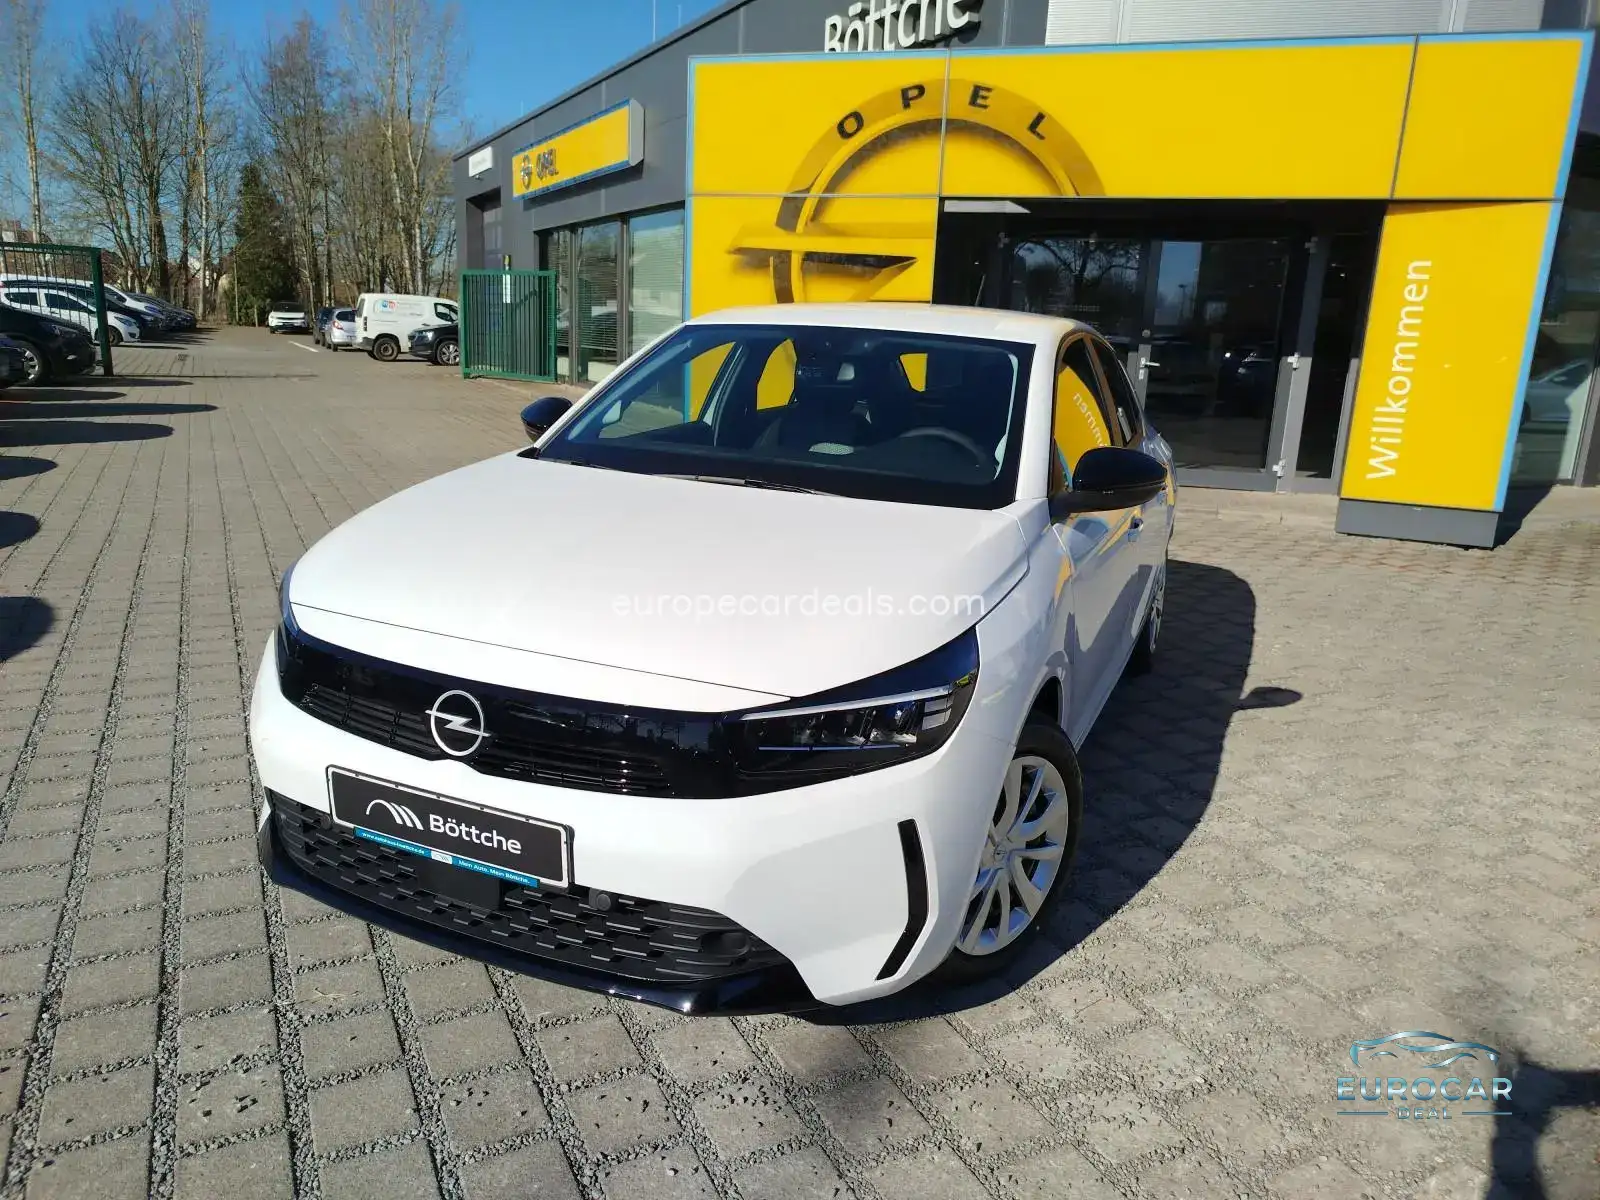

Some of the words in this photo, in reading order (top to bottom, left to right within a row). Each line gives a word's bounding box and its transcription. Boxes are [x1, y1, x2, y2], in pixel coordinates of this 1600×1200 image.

[836, 83, 1047, 141] OPEL
[1365, 259, 1432, 480] Willkommen
[428, 813, 523, 855] Böttche
